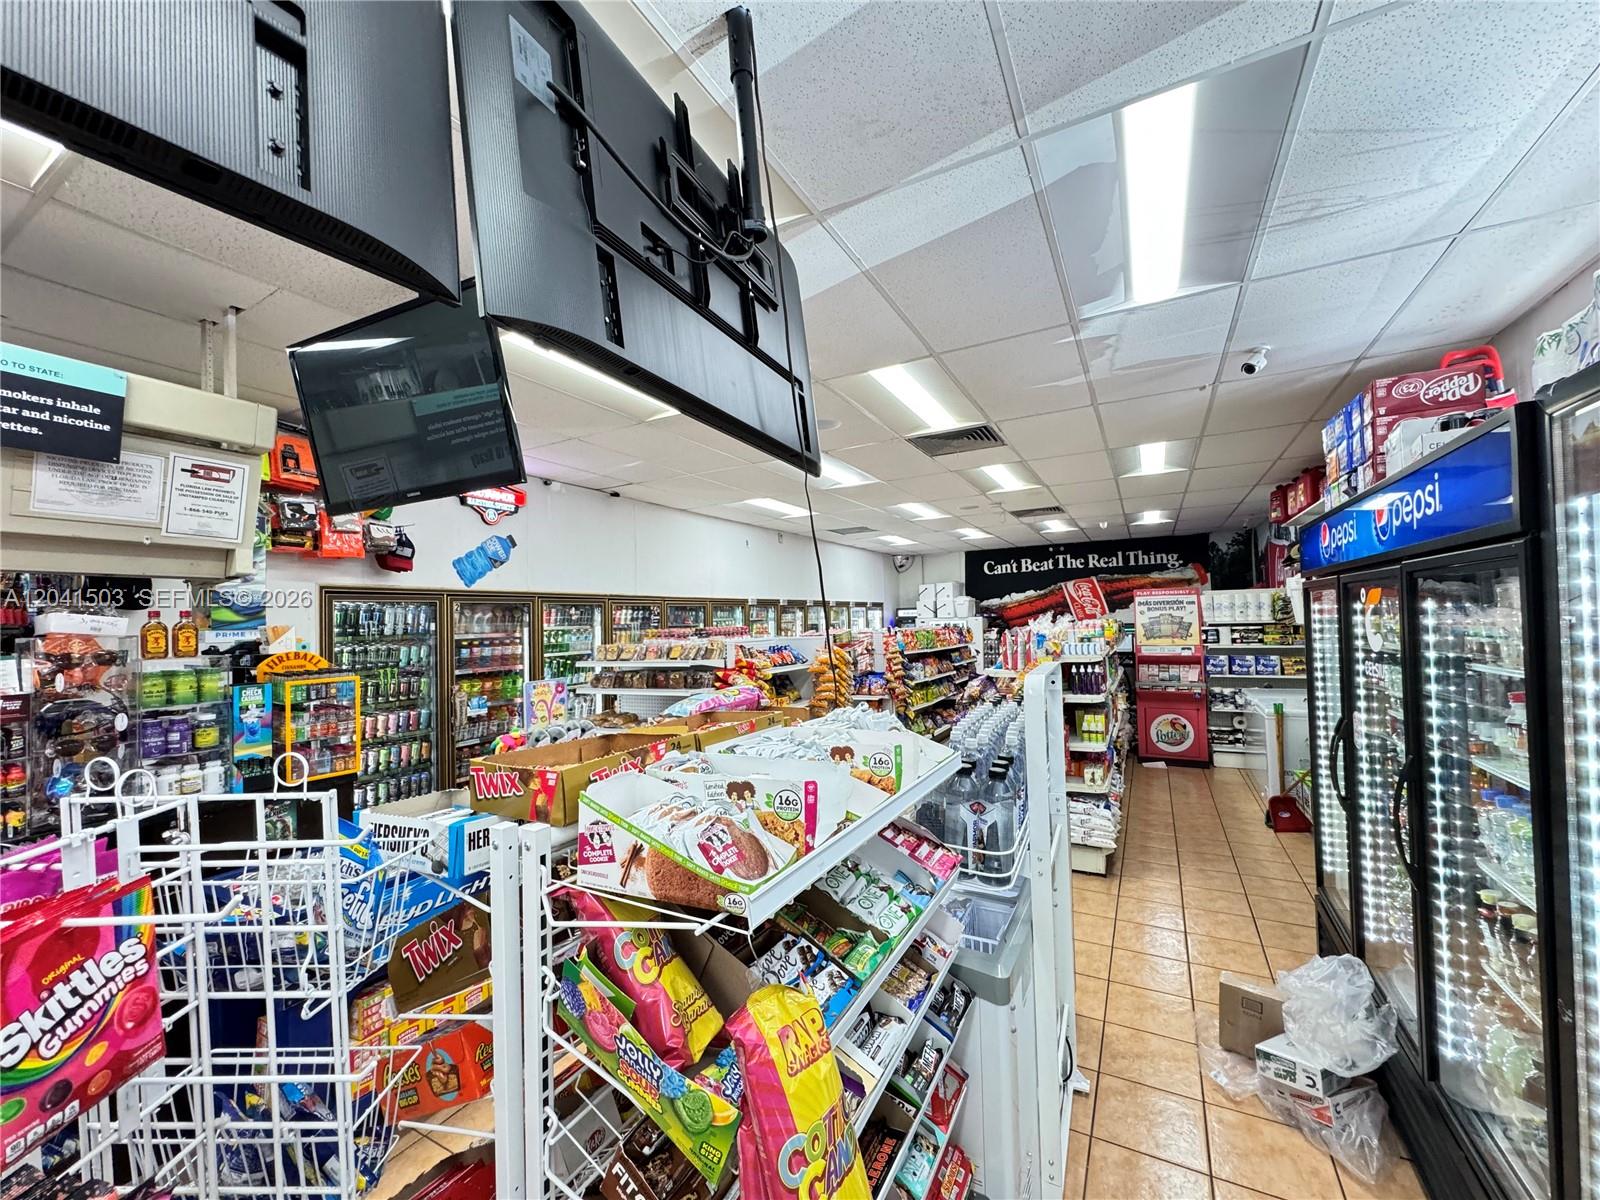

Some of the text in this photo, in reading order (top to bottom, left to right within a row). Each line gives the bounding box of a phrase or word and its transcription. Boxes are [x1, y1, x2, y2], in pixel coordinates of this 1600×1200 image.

[12, 361, 26, 370] TO
[28, 365, 65, 379] STATE:
[1404, 383, 1417, 393] 23
[1425, 372, 1475, 400] Pepper
[1439, 386, 1461, 402] Dr
[56, 398, 102, 415] inhale
[21, 408, 50, 421] and
[52, 413, 111, 432] nicotine
[1391, 471, 1441, 537] pepsi
[1330, 512, 1358, 554] pepsi
[983, 550, 1184, 575] Can't Beat The Real Thing.
[215, 631, 246, 639] PRIME
[266, 652, 322, 670] FIREBALL
[671, 741, 682, 751] 24
[872, 756, 890, 766] 16G
[470, 764, 524, 801] TWIX
[779, 794, 799, 807] 16G
[583, 849, 613, 857] COMPLETE
[727, 898, 743, 906] 16G
[858, 885, 884, 909] ONE
[879, 905, 904, 930] ONE
[401, 919, 464, 984] TWIX
[0, 936, 147, 1068] Skittles
[38, 958, 150, 1059] Gummies
[776, 1007, 826, 1063] RAP
[614, 1034, 663, 1081] JOLLY
[617, 1048, 659, 1088] RANCHER
[787, 1036, 832, 1077] SNACKS
[618, 1060, 660, 1101] SOUR
[700, 1149, 720, 1163] SIZE
[702, 1142, 722, 1158] KING
[612, 1162, 638, 1194] FIT
